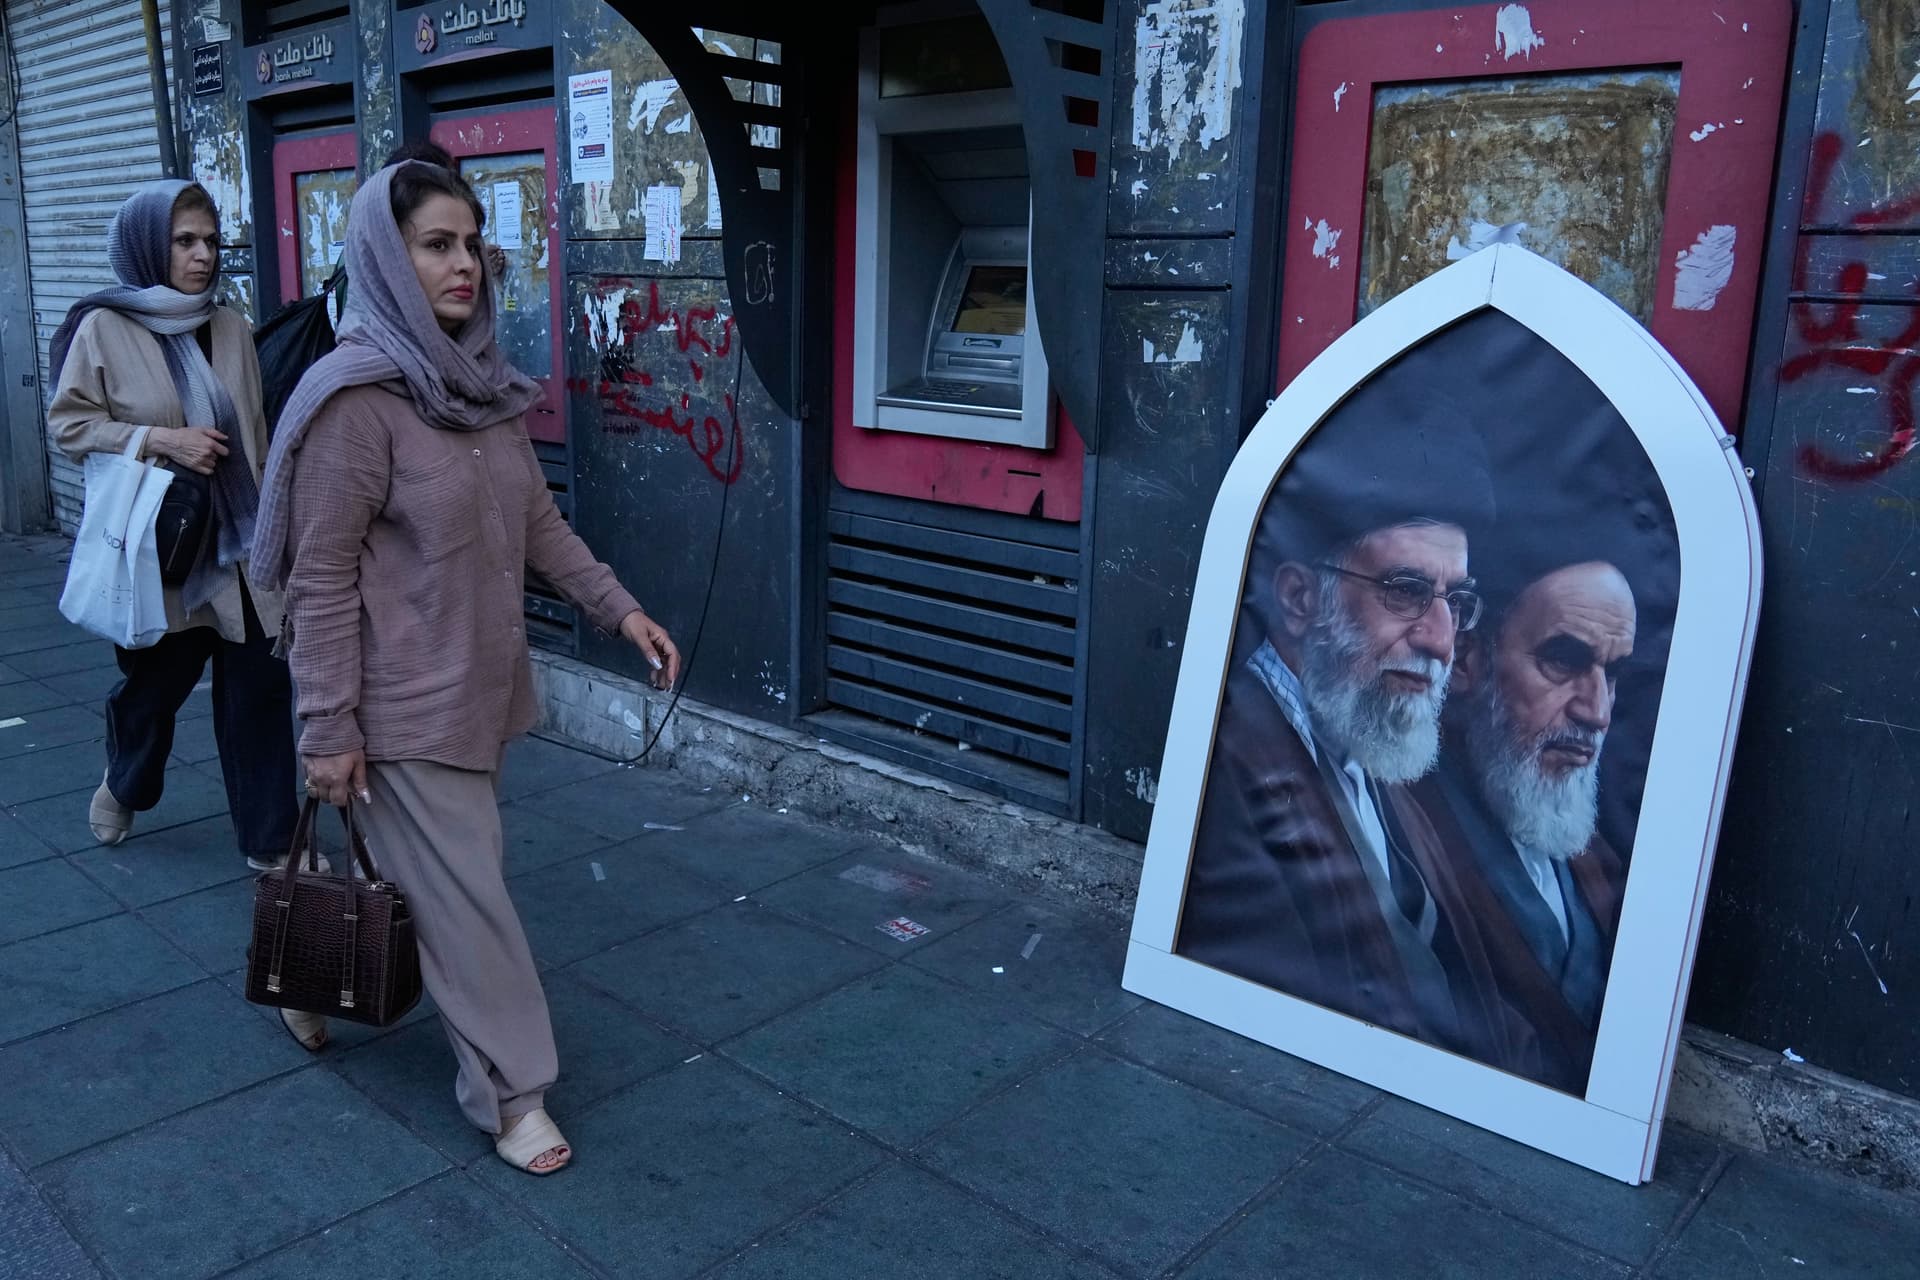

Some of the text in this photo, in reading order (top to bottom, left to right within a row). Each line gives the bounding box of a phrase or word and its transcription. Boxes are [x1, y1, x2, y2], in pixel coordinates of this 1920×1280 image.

[441, 3, 478, 34] ملت
[466, 31, 494, 45] mellat
[274, 41, 301, 67] ملت
[275, 67, 312, 82] bank mellat
